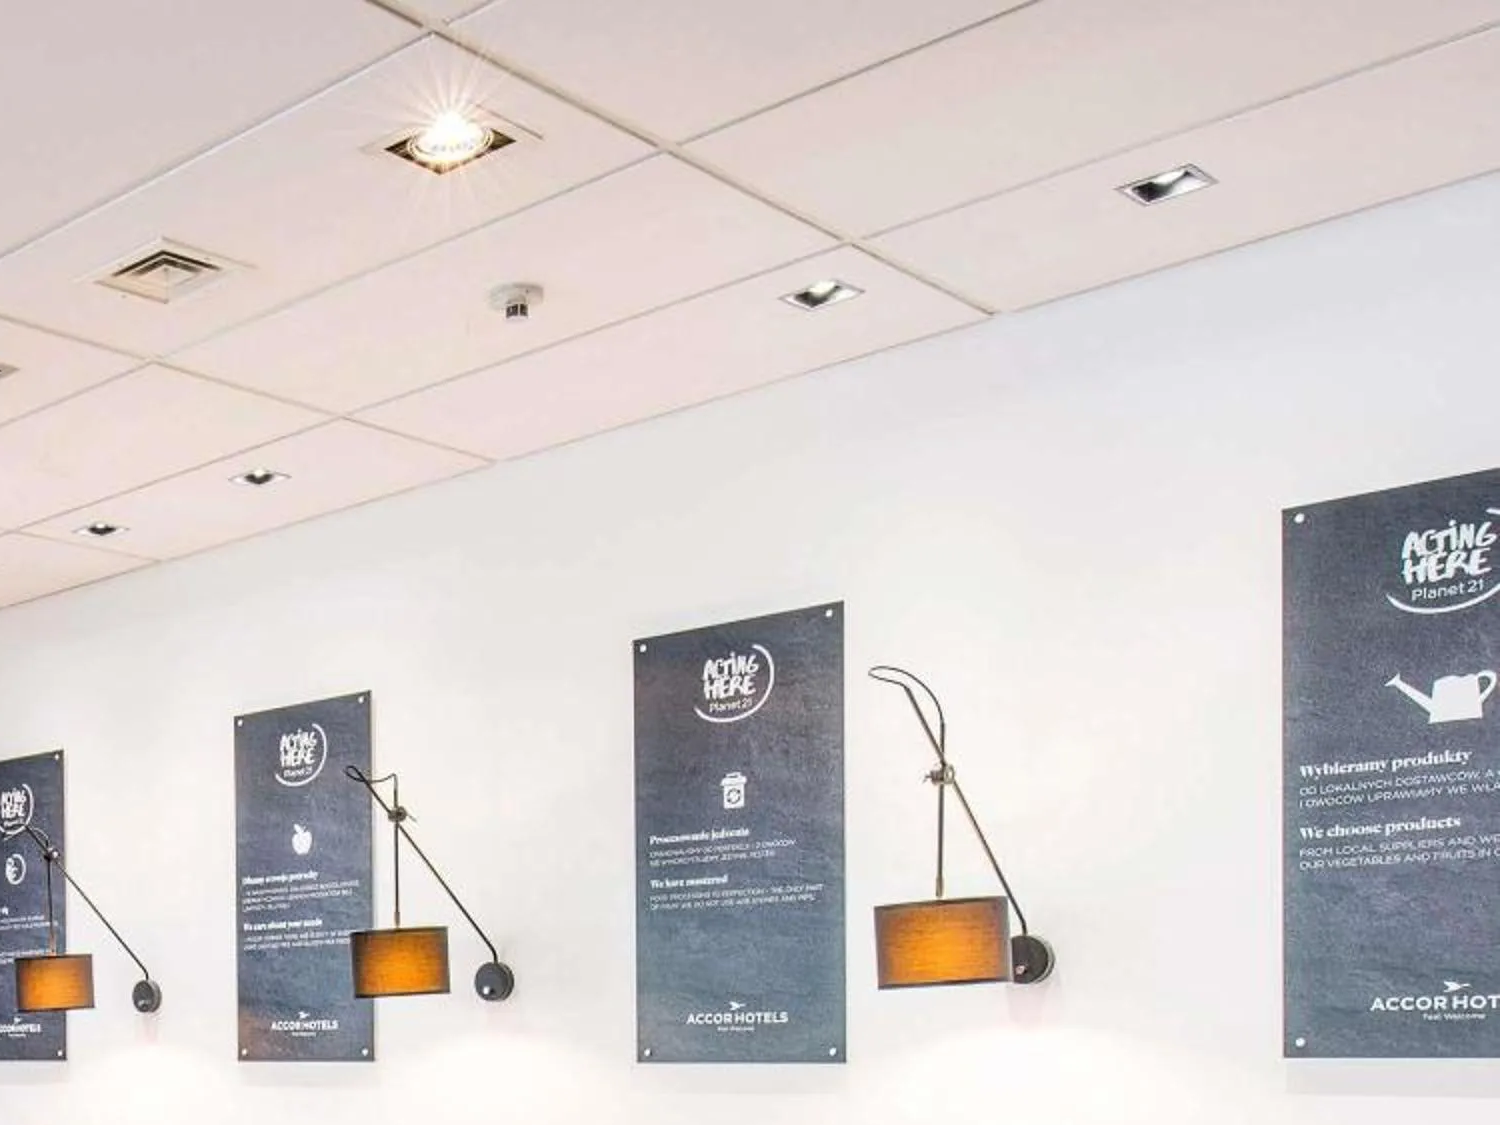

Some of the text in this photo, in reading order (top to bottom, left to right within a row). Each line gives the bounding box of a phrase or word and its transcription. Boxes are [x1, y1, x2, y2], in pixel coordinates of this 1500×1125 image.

[1401, 519, 1497, 558] ACTING
[1402, 547, 1492, 584] HERE
[1411, 579, 1484, 601] Planet 21
[703, 651, 759, 680] ACTING
[703, 674, 757, 700] HERE
[1391, 749, 1473, 773] produkty
[1299, 816, 1461, 840] We choose products
